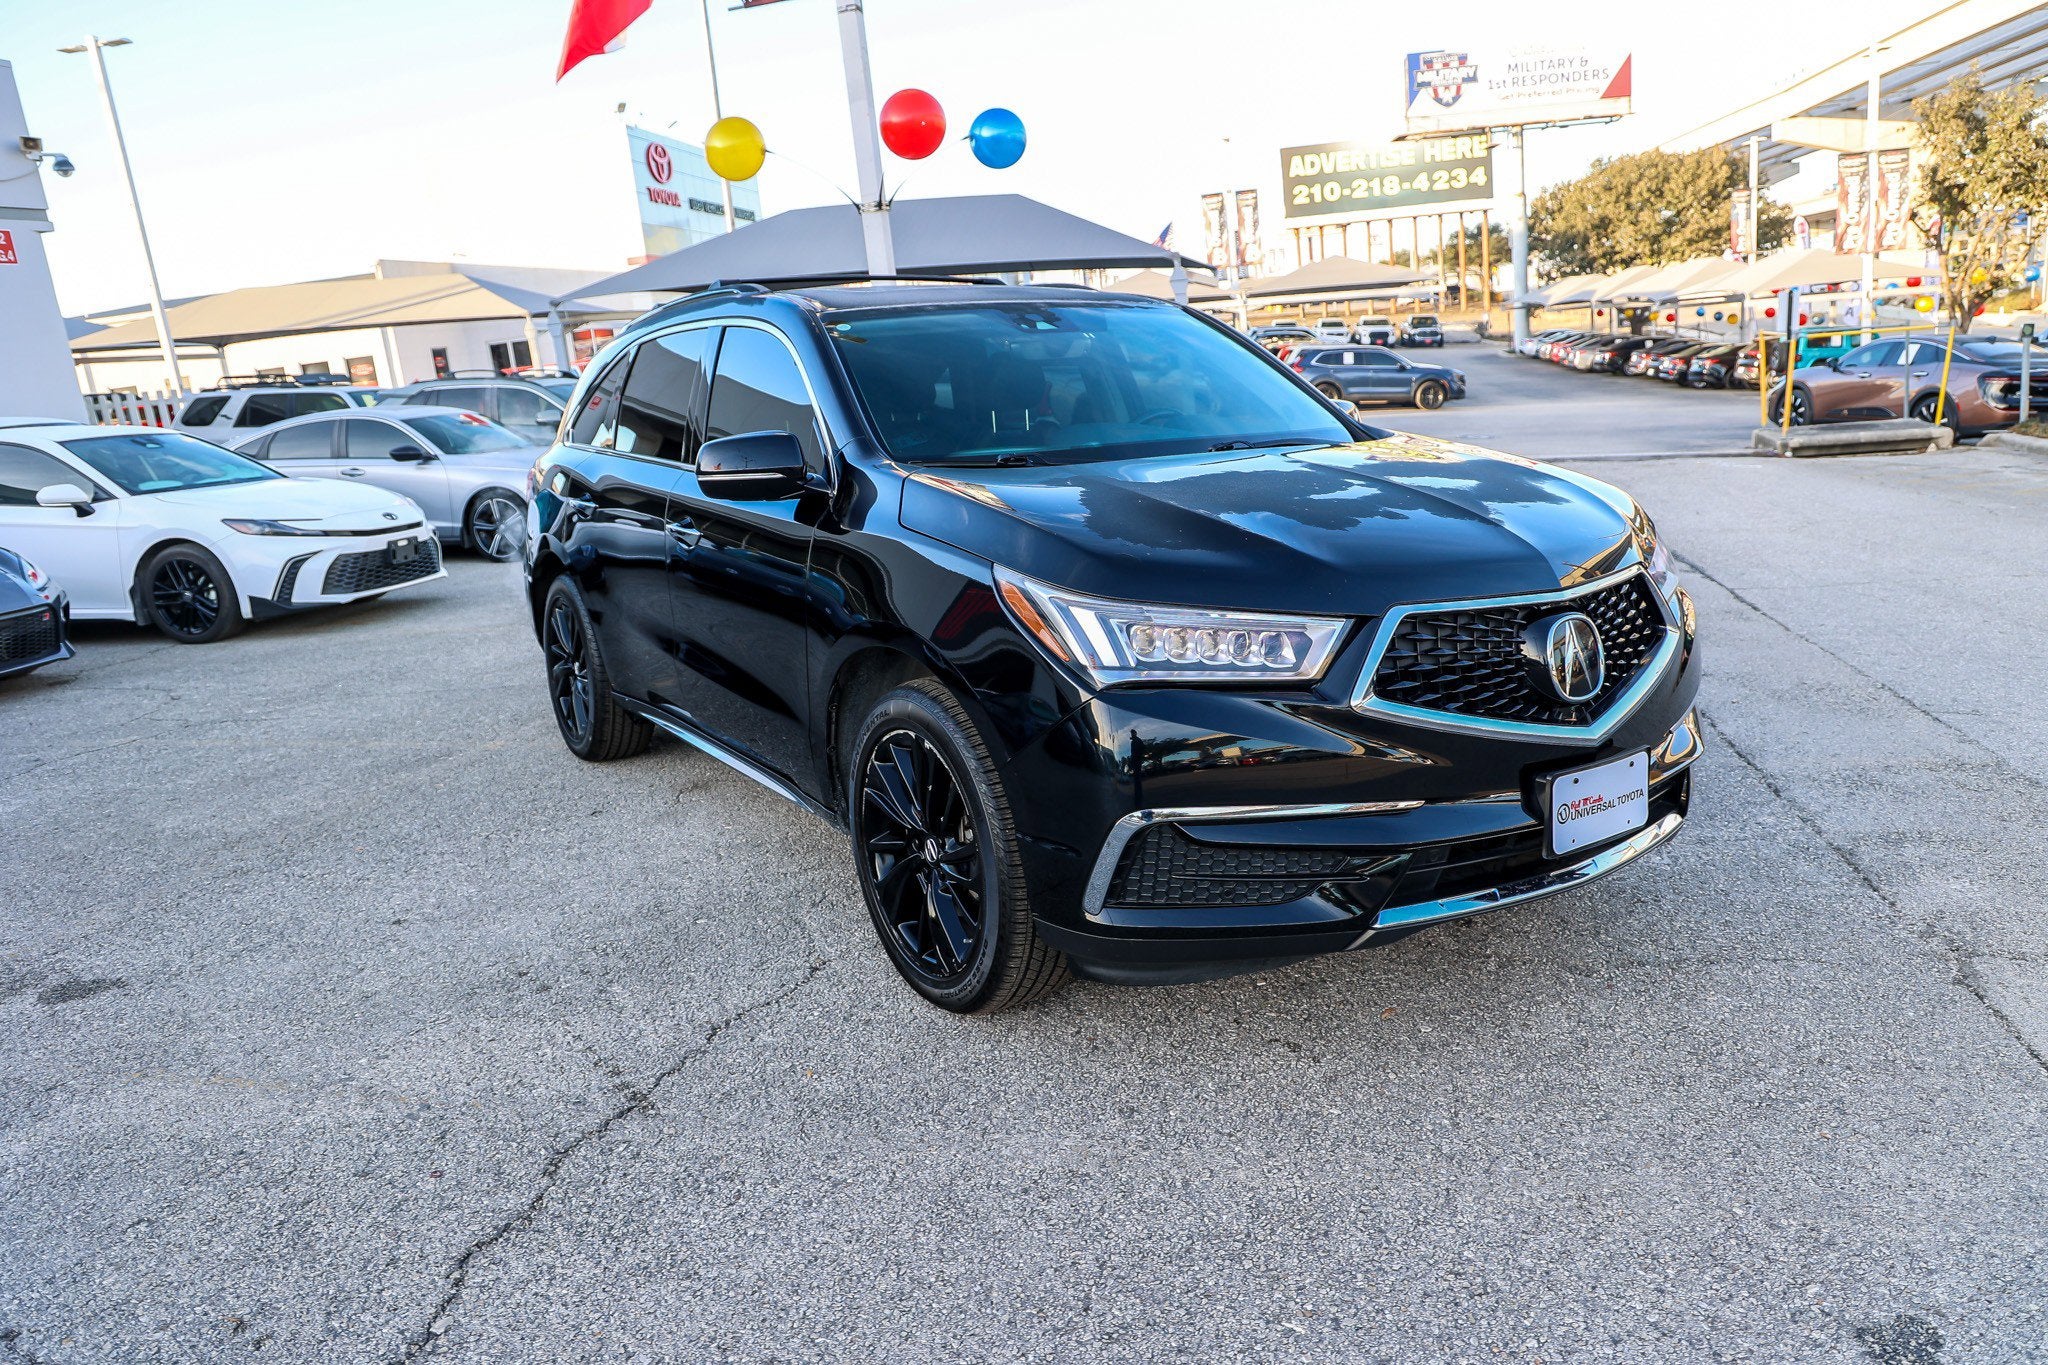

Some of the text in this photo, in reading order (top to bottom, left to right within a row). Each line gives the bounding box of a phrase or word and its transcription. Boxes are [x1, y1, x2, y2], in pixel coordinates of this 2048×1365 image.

[1507, 57, 1575, 74] MILITARY
[1512, 68, 1609, 88] RESPONDERS
[1289, 134, 1488, 178] ADVERTISE HERE
[646, 187, 681, 207] TOYOTA
[1292, 165, 1488, 206] 210-218-4234
[1571, 799, 1616, 820] UNIVERSAL
[1617, 788, 1644, 806] TOYOTA
